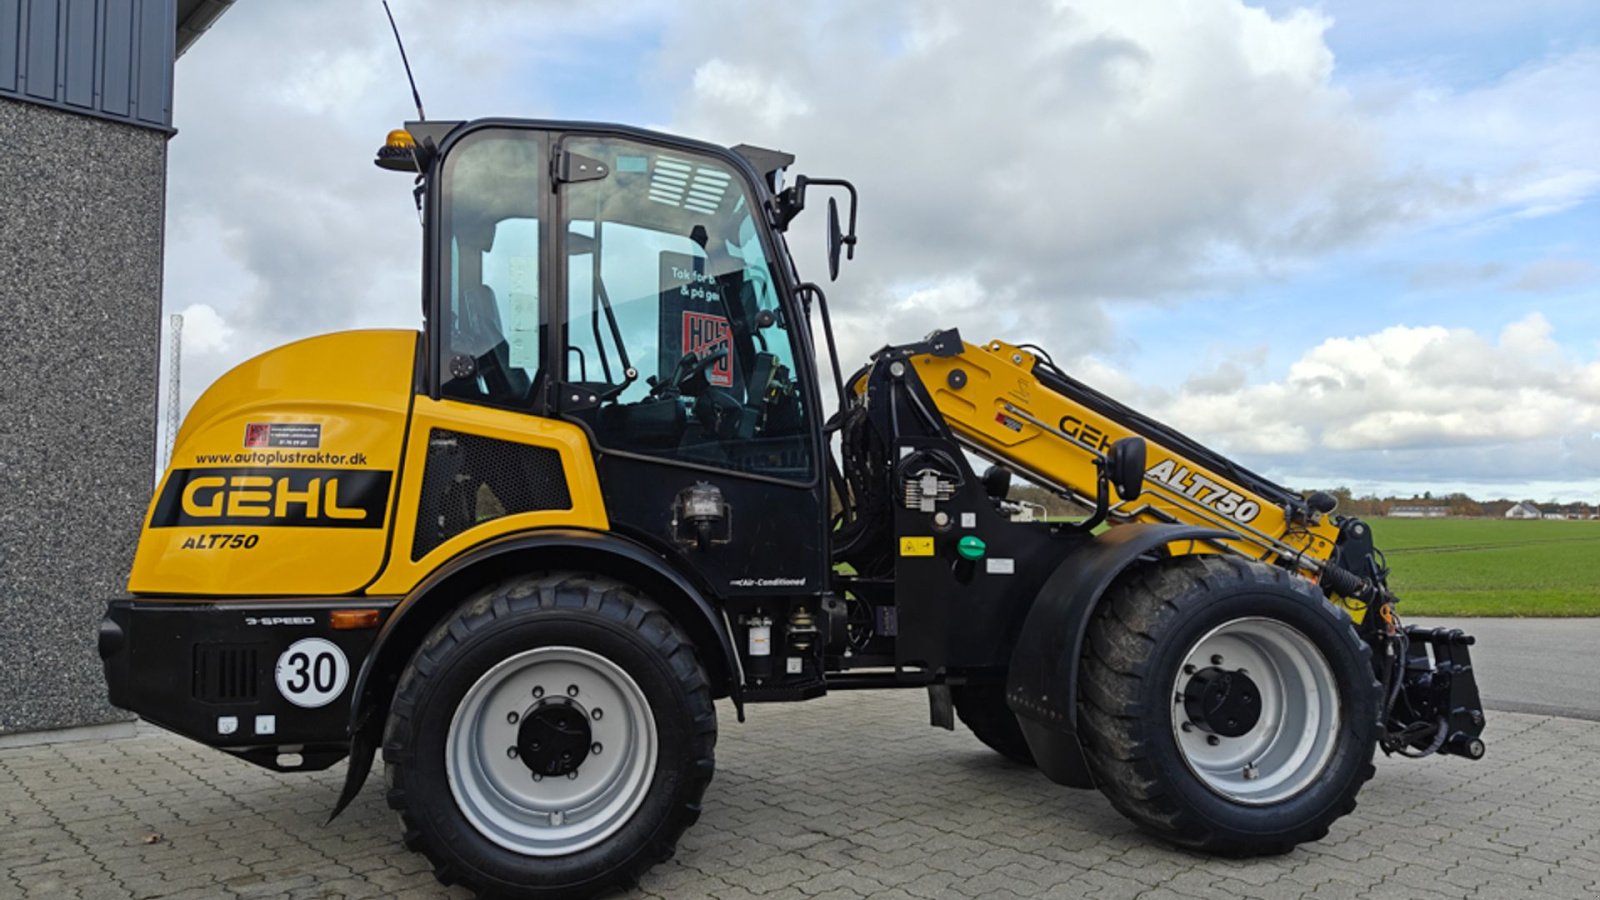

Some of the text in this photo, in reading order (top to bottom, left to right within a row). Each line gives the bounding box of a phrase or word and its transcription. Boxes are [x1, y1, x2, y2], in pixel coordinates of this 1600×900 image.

[672, 266, 690, 280] Tak
[692, 270, 706, 283] for
[680, 284, 690, 296] &
[689, 316, 730, 352] HOLT
[196, 450, 367, 466] www.autoplustraktor.dk
[181, 476, 368, 519] GEHL
[1144, 458, 1261, 524] ALT750
[182, 533, 260, 549] ALT750
[244, 616, 316, 626] 3-SPEED
[286, 651, 337, 694] 30
